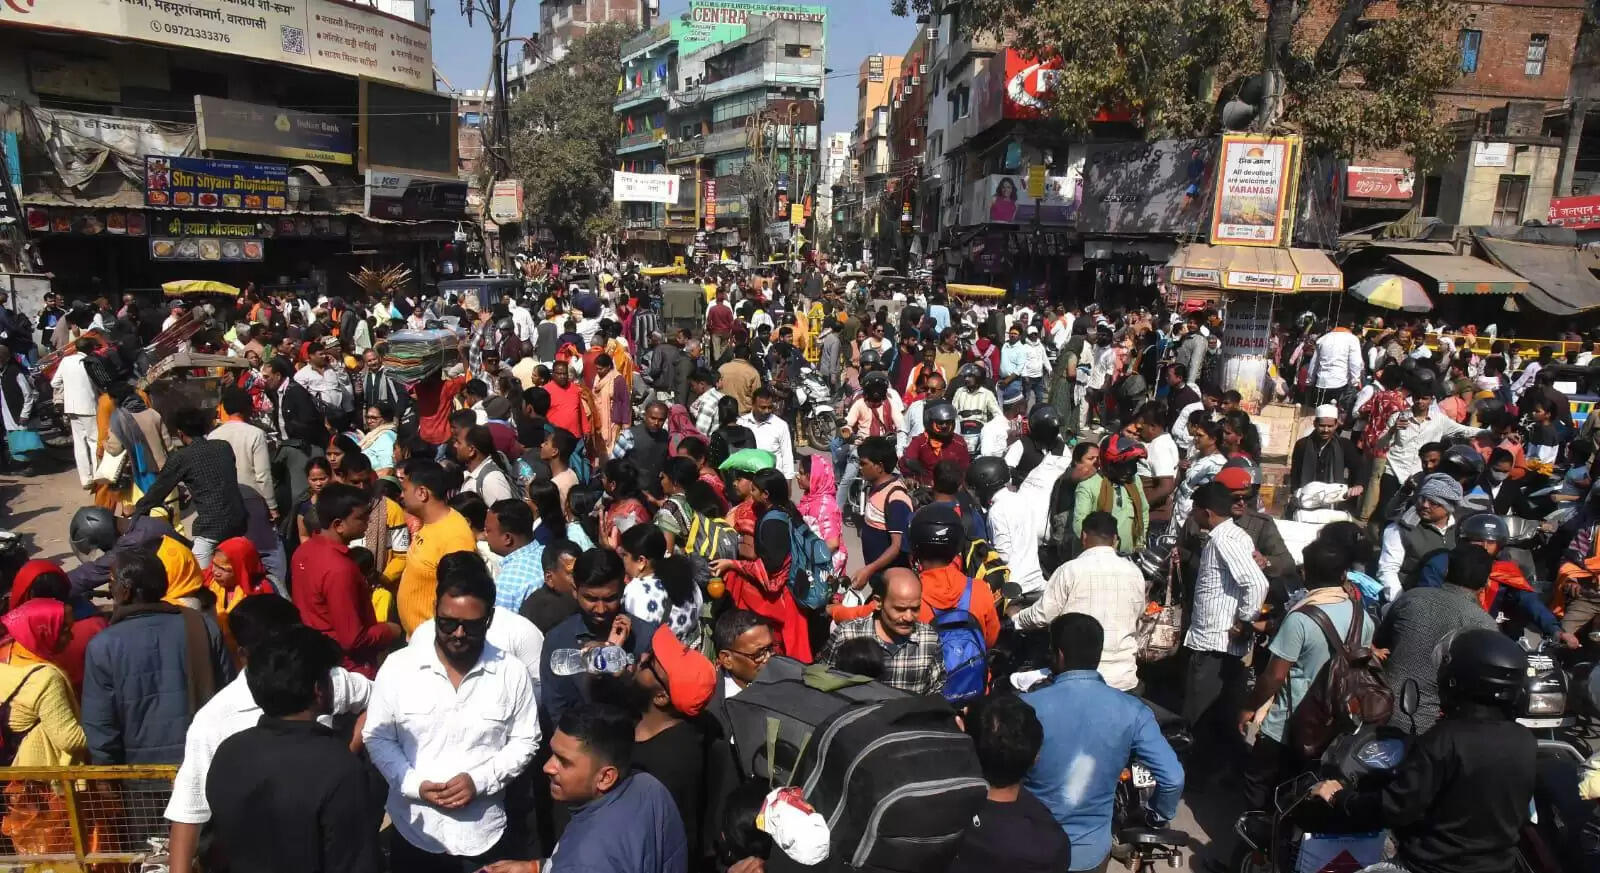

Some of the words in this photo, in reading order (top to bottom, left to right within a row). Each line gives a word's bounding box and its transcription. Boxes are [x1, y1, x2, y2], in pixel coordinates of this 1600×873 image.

[227, 14, 267, 30] वाराणसी
[693, 8, 752, 24] CENTRA
[165, 24, 231, 43] 09721333376
[322, 121, 339, 133] Bank
[1244, 169, 1273, 177] devotees
[197, 174, 231, 192] Shyam
[1240, 177, 1268, 185] welcome
[1229, 185, 1274, 195] VARANASI
[1560, 206, 1594, 217] जलपान
[169, 217, 182, 235] श्री
